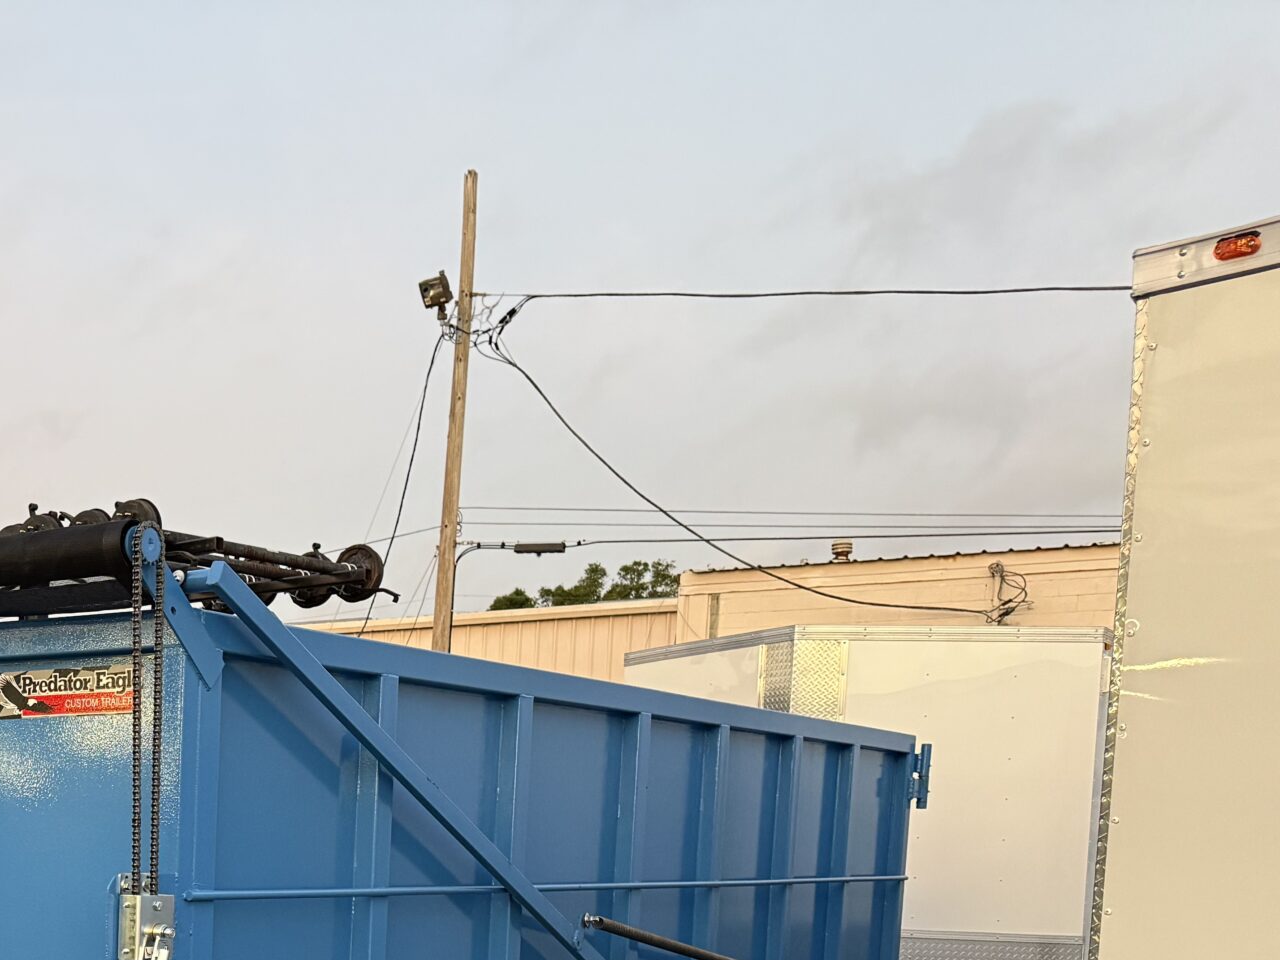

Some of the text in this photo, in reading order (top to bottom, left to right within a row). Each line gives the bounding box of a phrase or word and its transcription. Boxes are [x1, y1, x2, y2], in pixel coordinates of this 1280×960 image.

[22, 670, 133, 695] Predator Eagl
[65, 697, 133, 709] CUSTOM TRAILER
